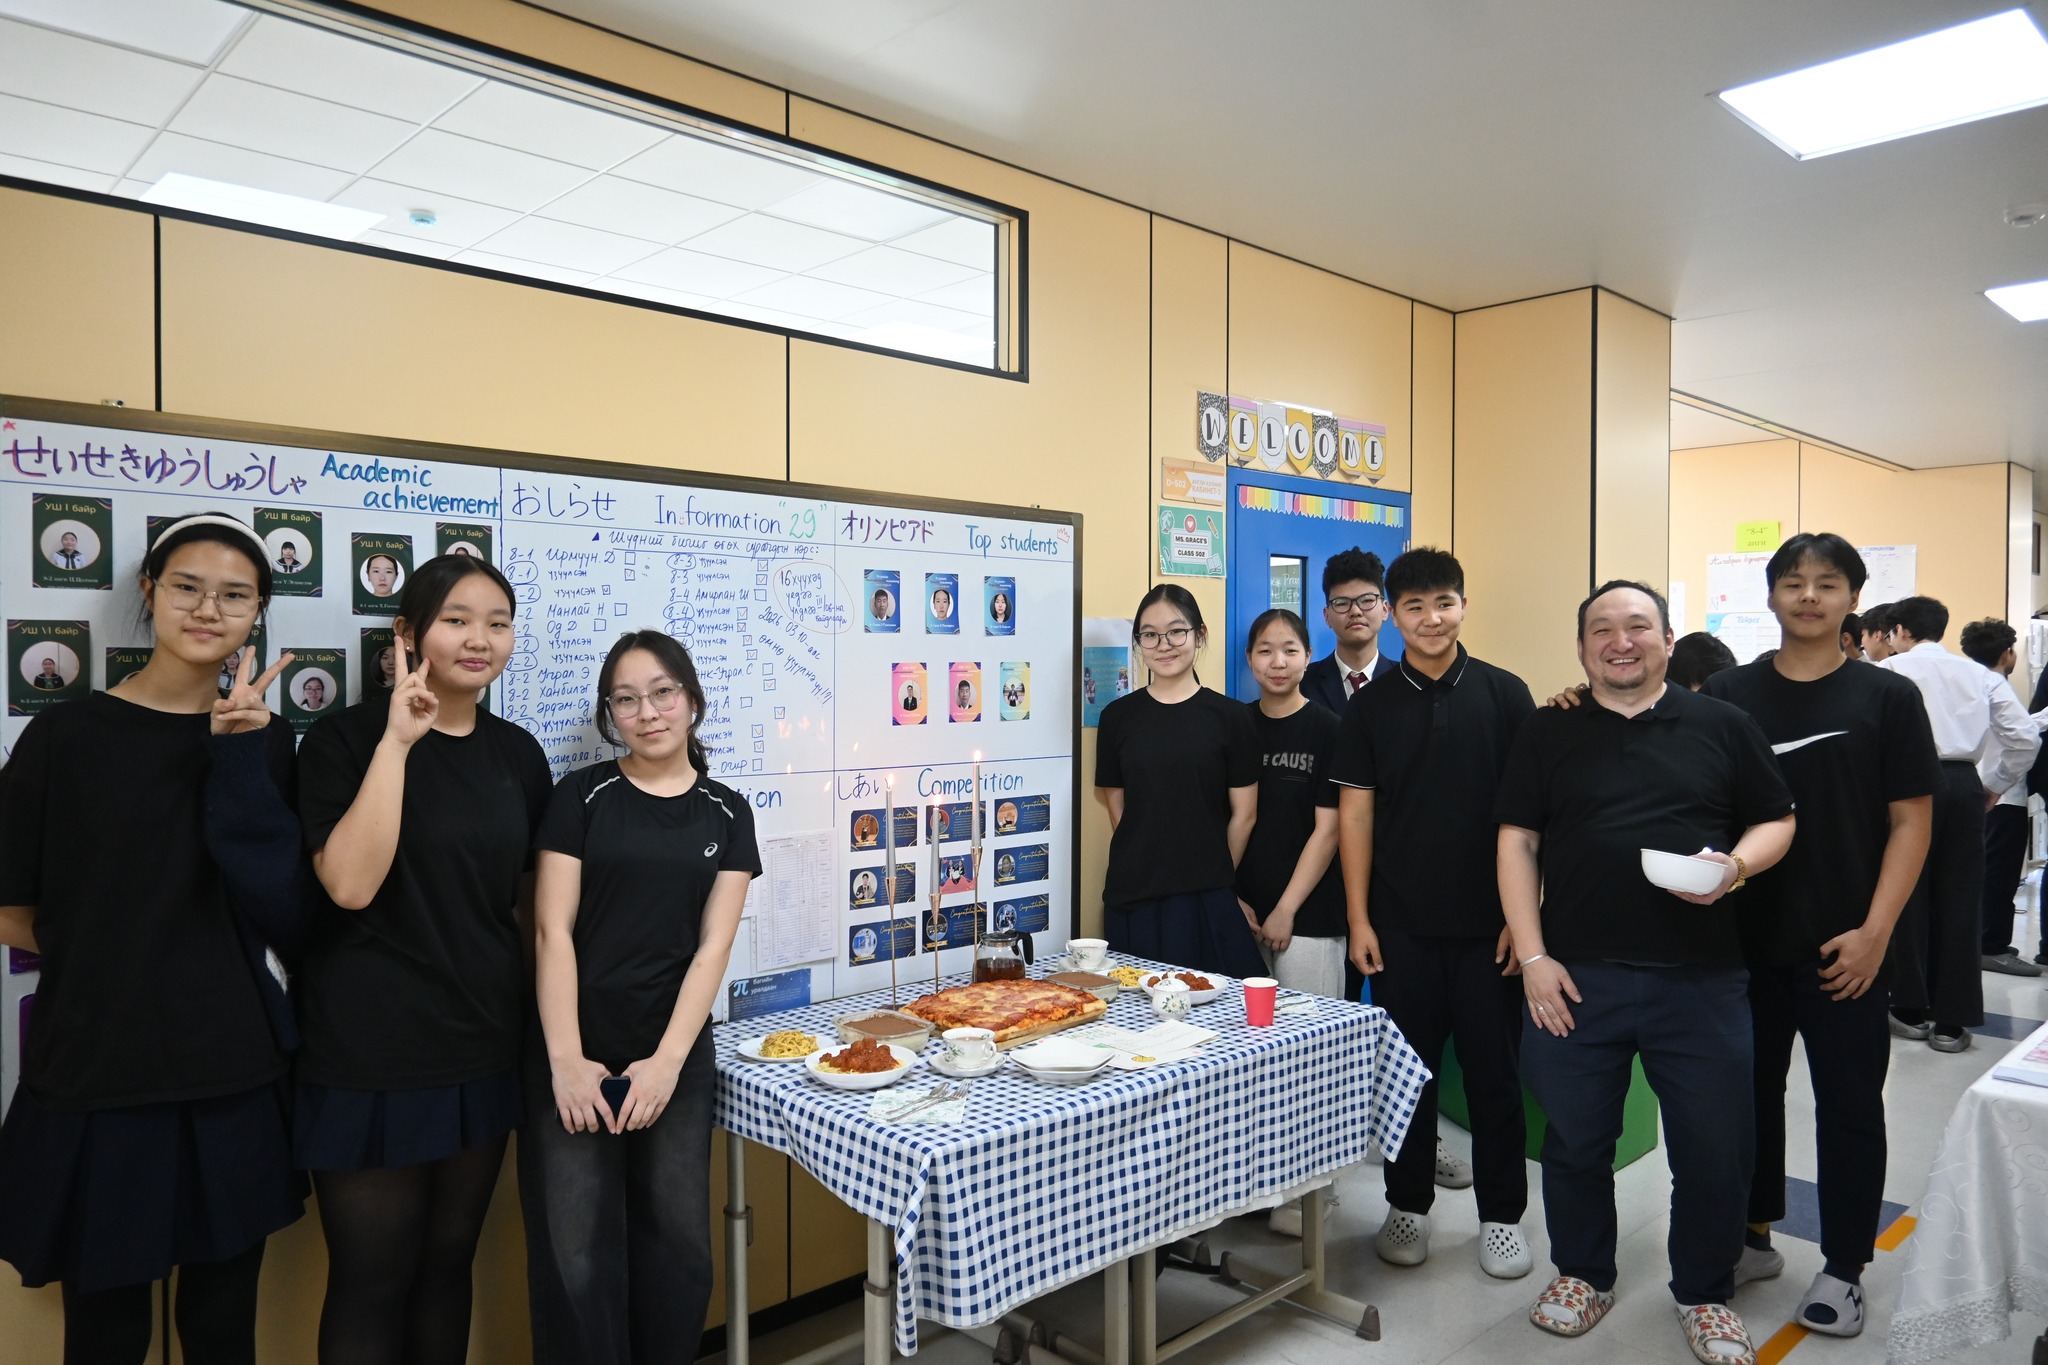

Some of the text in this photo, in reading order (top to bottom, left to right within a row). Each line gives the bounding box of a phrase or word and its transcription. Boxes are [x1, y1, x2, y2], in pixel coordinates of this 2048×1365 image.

[1205, 412, 1378, 465] WELCOME
[320, 453, 433, 488] Academic
[44, 502, 62, 511] УШ
[71, 504, 97, 514] байр
[363, 484, 499, 517] achievement
[512, 482, 617, 521] おしらせ
[264, 512, 279, 520] УШ
[290, 513, 311, 523] байр
[654, 494, 782, 534] Information
[444, 528, 457, 536] УШ
[466, 530, 484, 539] байр
[841, 509, 935, 544] オリンピアド
[359, 540, 374, 548] УШ
[385, 541, 404, 550] байр
[965, 524, 1058, 559] Top students
[509, 547, 534, 561] 8-1
[673, 553, 693, 568] 8-3
[1177, 549, 1206, 558] CLASS 502
[507, 565, 588, 580] 8-1 үзүүлсэн
[670, 569, 689, 585] 8-3
[780, 570, 791, 587] 16
[512, 586, 597, 601] -2 үзүүлсэн
[669, 587, 690, 602] 8-4
[597, 602, 605, 616] Н
[668, 605, 690, 619] 8-4
[21, 626, 38, 635] УШ
[54, 627, 79, 636] байр
[670, 620, 734, 635] 8-4 үзүүлсэн
[371, 633, 385, 641] УШ
[548, 638, 592, 650] үзүүлсэн
[759, 634, 785, 656] өмнө
[116, 654, 132, 663] УШ
[316, 654, 336, 663] байр
[551, 654, 596, 665] үзүүлсэн
[508, 672, 530, 686] 8-2
[581, 666, 590, 680] Э
[508, 688, 530, 702] 8-2
[506, 704, 529, 719] 8-2
[541, 717, 593, 734] үзүүлсэн
[540, 735, 583, 749] үзүүлсэн
[1271, 752, 1315, 774] CAUSE
[917, 767, 1024, 801] Compeition
